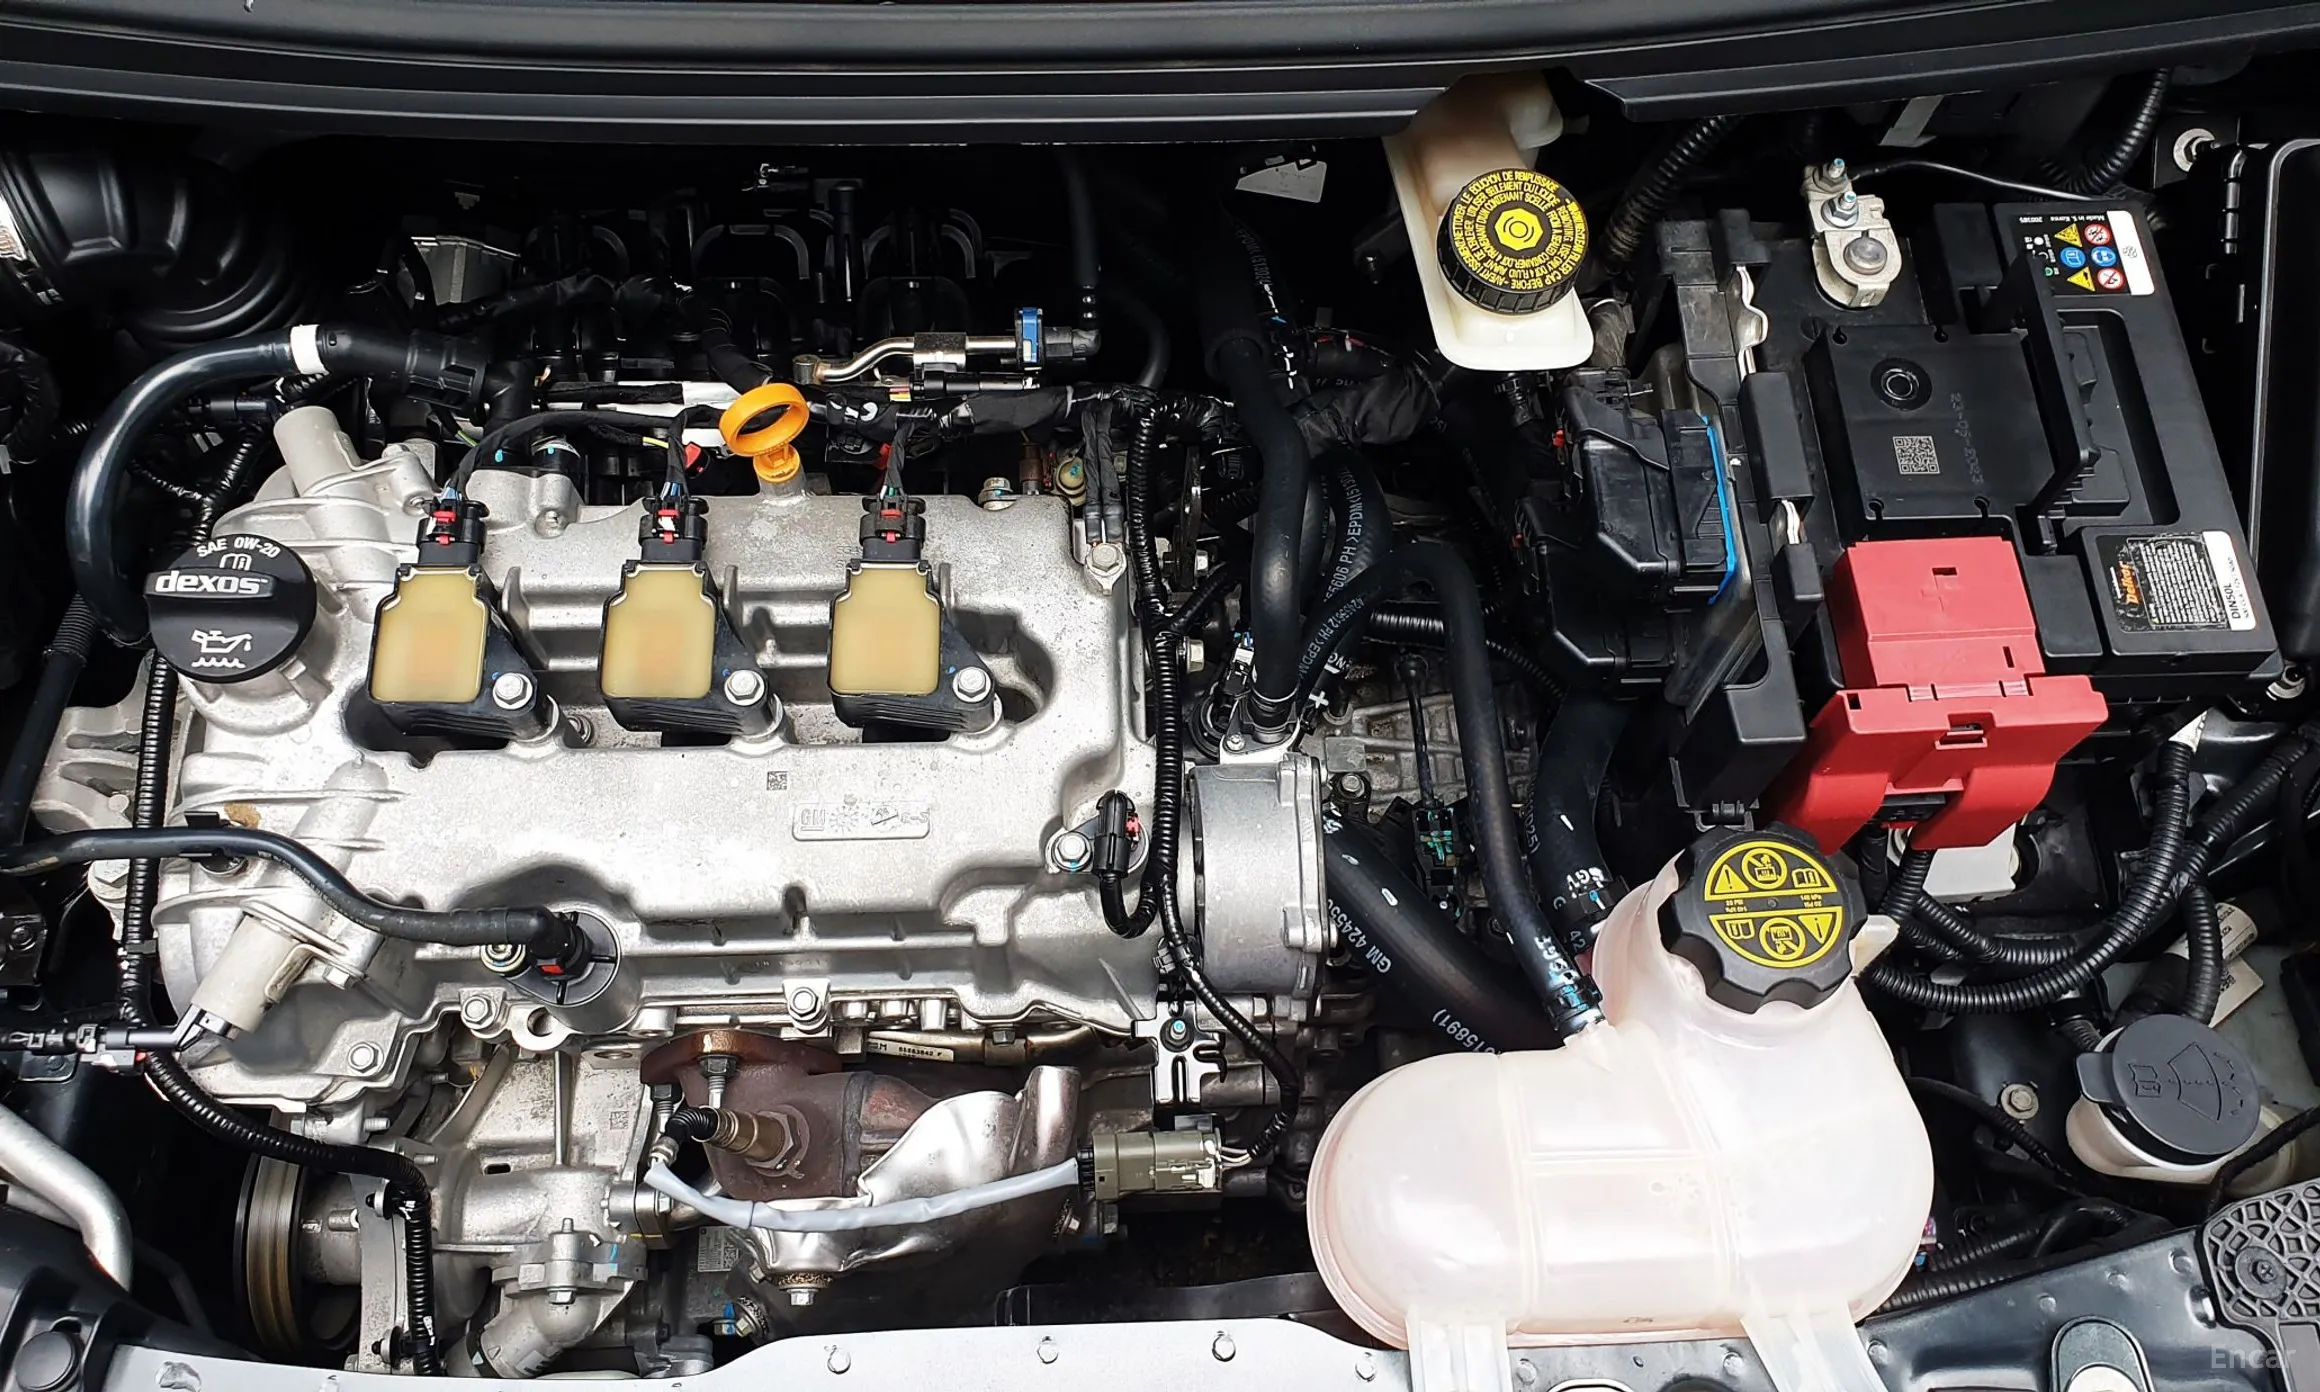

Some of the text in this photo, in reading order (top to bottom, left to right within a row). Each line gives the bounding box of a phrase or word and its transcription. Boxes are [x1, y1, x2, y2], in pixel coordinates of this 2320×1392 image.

[1460, 192, 1473, 205] LE
[1502, 170, 1513, 182] DE
[1523, 182, 1534, 193] DU
[1511, 279, 1544, 290] BEFORE
[1545, 271, 1562, 286] CAP
[196, 536, 281, 559] SAE 0W-20
[1339, 546, 1356, 565] PH
[154, 570, 260, 595] dexos
[1367, 948, 1392, 974] GM
